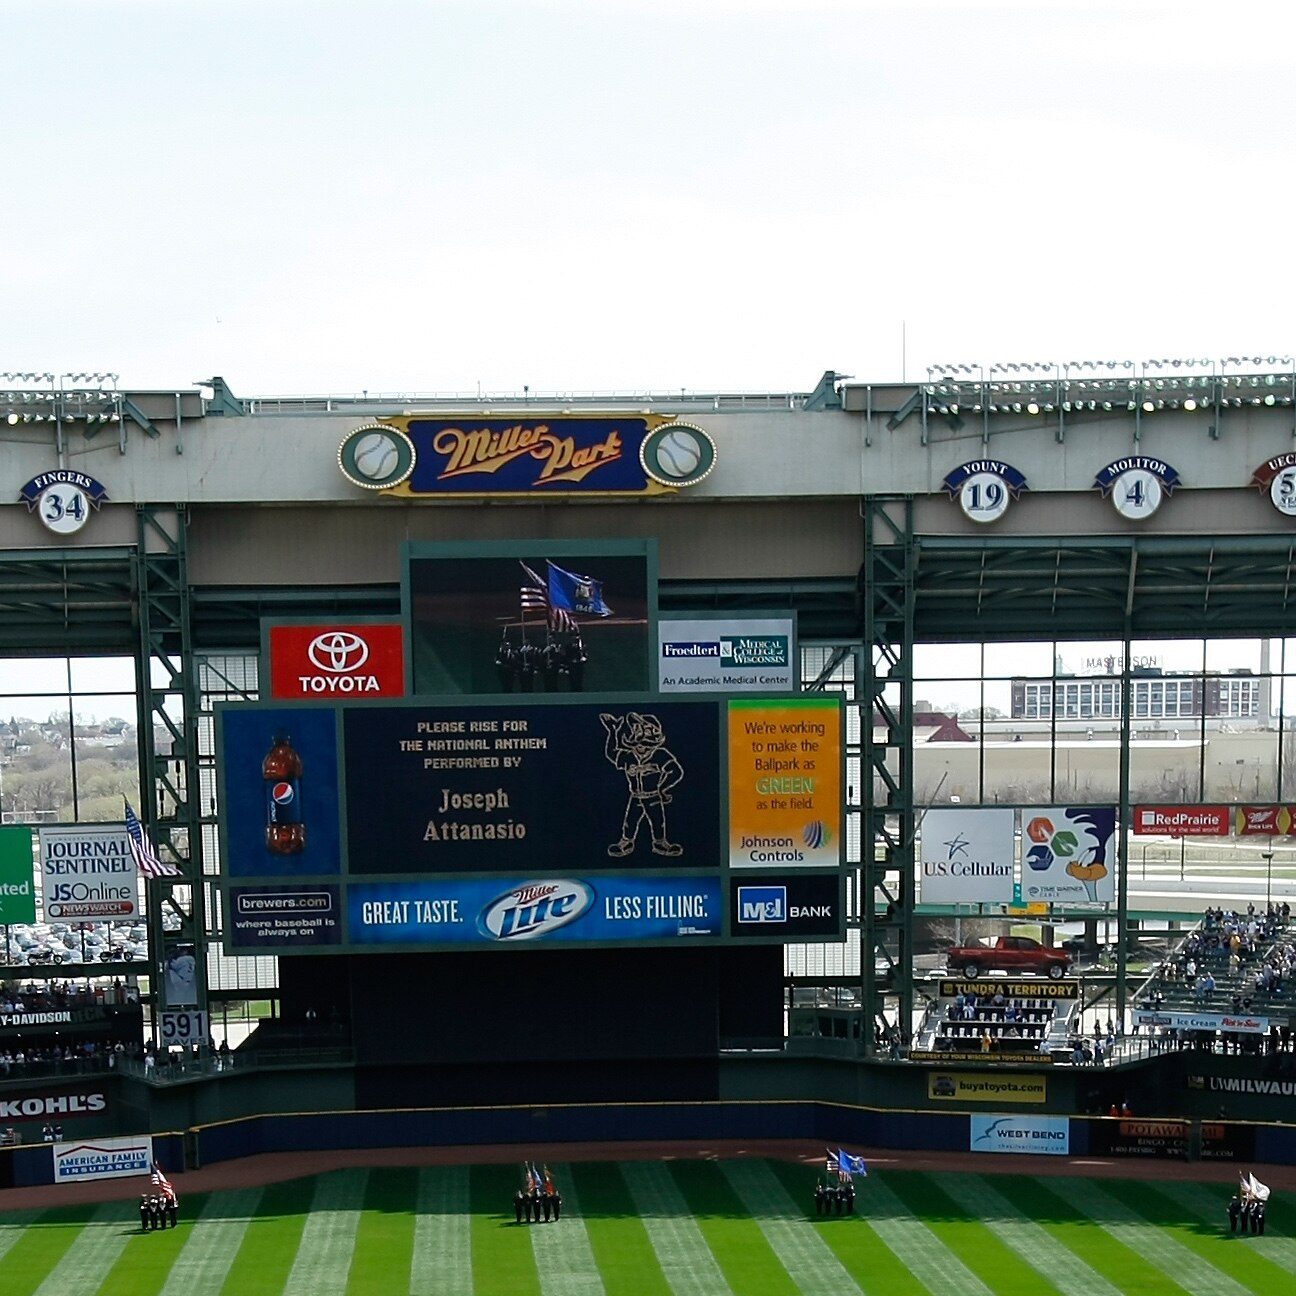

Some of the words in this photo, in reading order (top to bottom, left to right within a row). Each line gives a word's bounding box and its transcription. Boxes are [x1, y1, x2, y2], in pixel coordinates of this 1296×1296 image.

[433, 425, 549, 480] Miller
[530, 430, 623, 486] Park
[963, 461, 1008, 475] YOUNT
[1108, 458, 1167, 476] MOLITOR
[34, 471, 92, 488] FINGERS
[967, 483, 1004, 511] 19
[1126, 480, 1145, 507] 4
[46, 494, 85, 522] 34
[664, 644, 719, 656] Froedtert
[299, 676, 380, 692] TOYOTA
[663, 677, 675, 685] An
[679, 676, 720, 685] Academic
[723, 676, 756, 684] Medical
[759, 675, 788, 684] Center
[417, 721, 466, 733] PLEASE
[470, 720, 498, 732] RISE
[502, 720, 528, 732] FOR
[744, 722, 776, 734] We're
[780, 722, 825, 736] working
[399, 740, 423, 751] THE
[427, 739, 490, 751] NATIONAL
[495, 738, 547, 750] ANTHEM
[752, 742, 763, 752] to
[767, 740, 797, 752] make
[801, 739, 818, 751] the
[424, 757, 499, 769] PERFORMED
[503, 757, 521, 767] BY
[755, 758, 800, 773] Ballpark
[804, 760, 816, 770] as
[756, 776, 816, 795] GREEN
[438, 788, 509, 813] Joseph
[756, 801, 768, 810] as
[771, 799, 787, 809] the
[1156, 813, 1219, 825] RedPrairie
[423, 819, 526, 841] Attanasio
[741, 836, 793, 849] Johnson
[46, 841, 131, 860] JOURNAL
[750, 849, 804, 862] Controls
[46, 858, 131, 875] SENTINEL
[951, 861, 1012, 877] Cellular
[50, 882, 131, 901] JSOnline
[512, 884, 559, 904] Miller
[242, 897, 327, 909] brewers.com
[606, 896, 641, 920] LESS
[647, 895, 708, 919] FILLING.
[363, 901, 410, 925] GREAT
[414, 900, 463, 923] TASTE.
[498, 893, 577, 939] Lite
[790, 906, 832, 918] BANK
[236, 920, 272, 929] where
[275, 918, 322, 928] baseball
[325, 918, 335, 927] is
[258, 928, 297, 938] always
[300, 928, 314, 936] on
[956, 983, 1004, 996] TUNDRA
[1007, 984, 1074, 996] TERRITORY
[162, 1013, 203, 1038] 591
[1190, 1019, 1217, 1028] Cream
[959, 1081, 1043, 1096] buyatoyota.com
[0, 1093, 106, 1118] KOHL'S
[997, 1130, 1030, 1138] WEST
[1032, 1131, 1065, 1140] BEND
[59, 1155, 108, 1167] AMERICAN
[111, 1152, 147, 1164] FAMILY
[65, 1162, 141, 1175] INSURANCE
